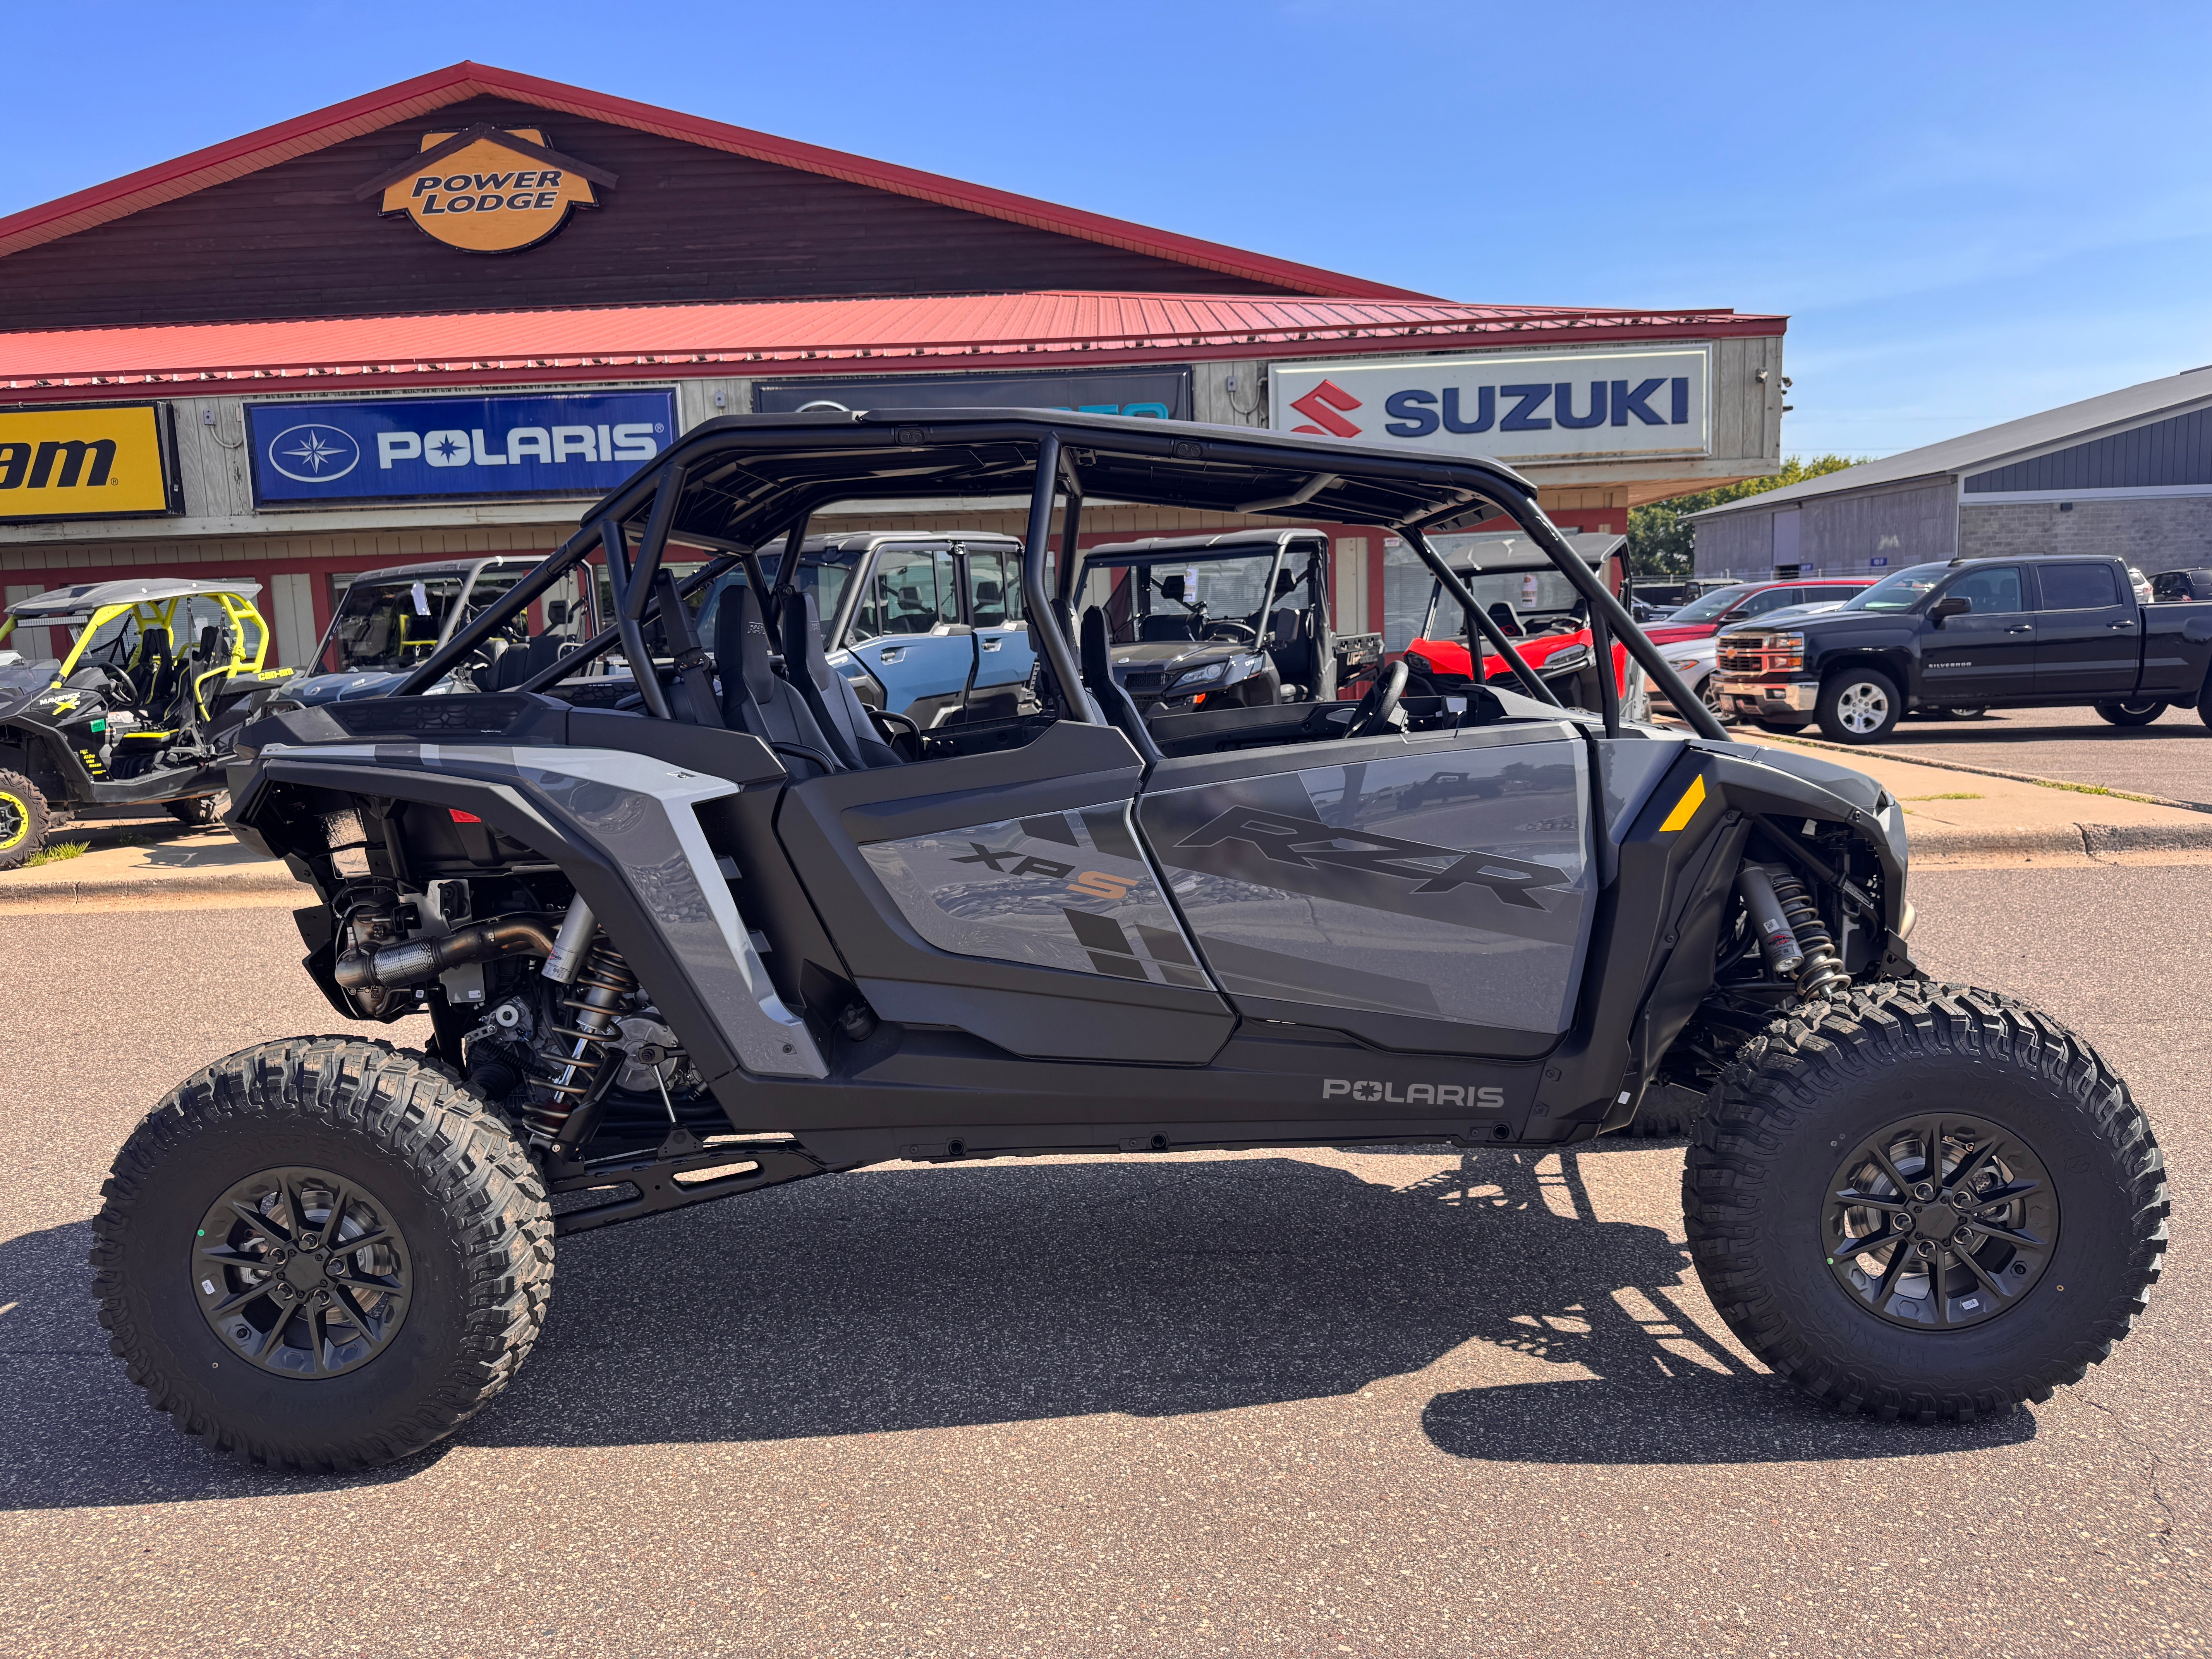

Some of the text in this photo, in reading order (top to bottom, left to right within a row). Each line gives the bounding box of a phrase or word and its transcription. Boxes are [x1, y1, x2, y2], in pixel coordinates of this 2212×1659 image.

[411, 170, 563, 198] POWER
[421, 191, 558, 216] LODGE
[1384, 377, 1689, 438] SUZUKI
[40, 692, 81, 705] MAVERICK
[1172, 804, 1573, 913] RZR
[1322, 1079, 1504, 1108] POLARIS
